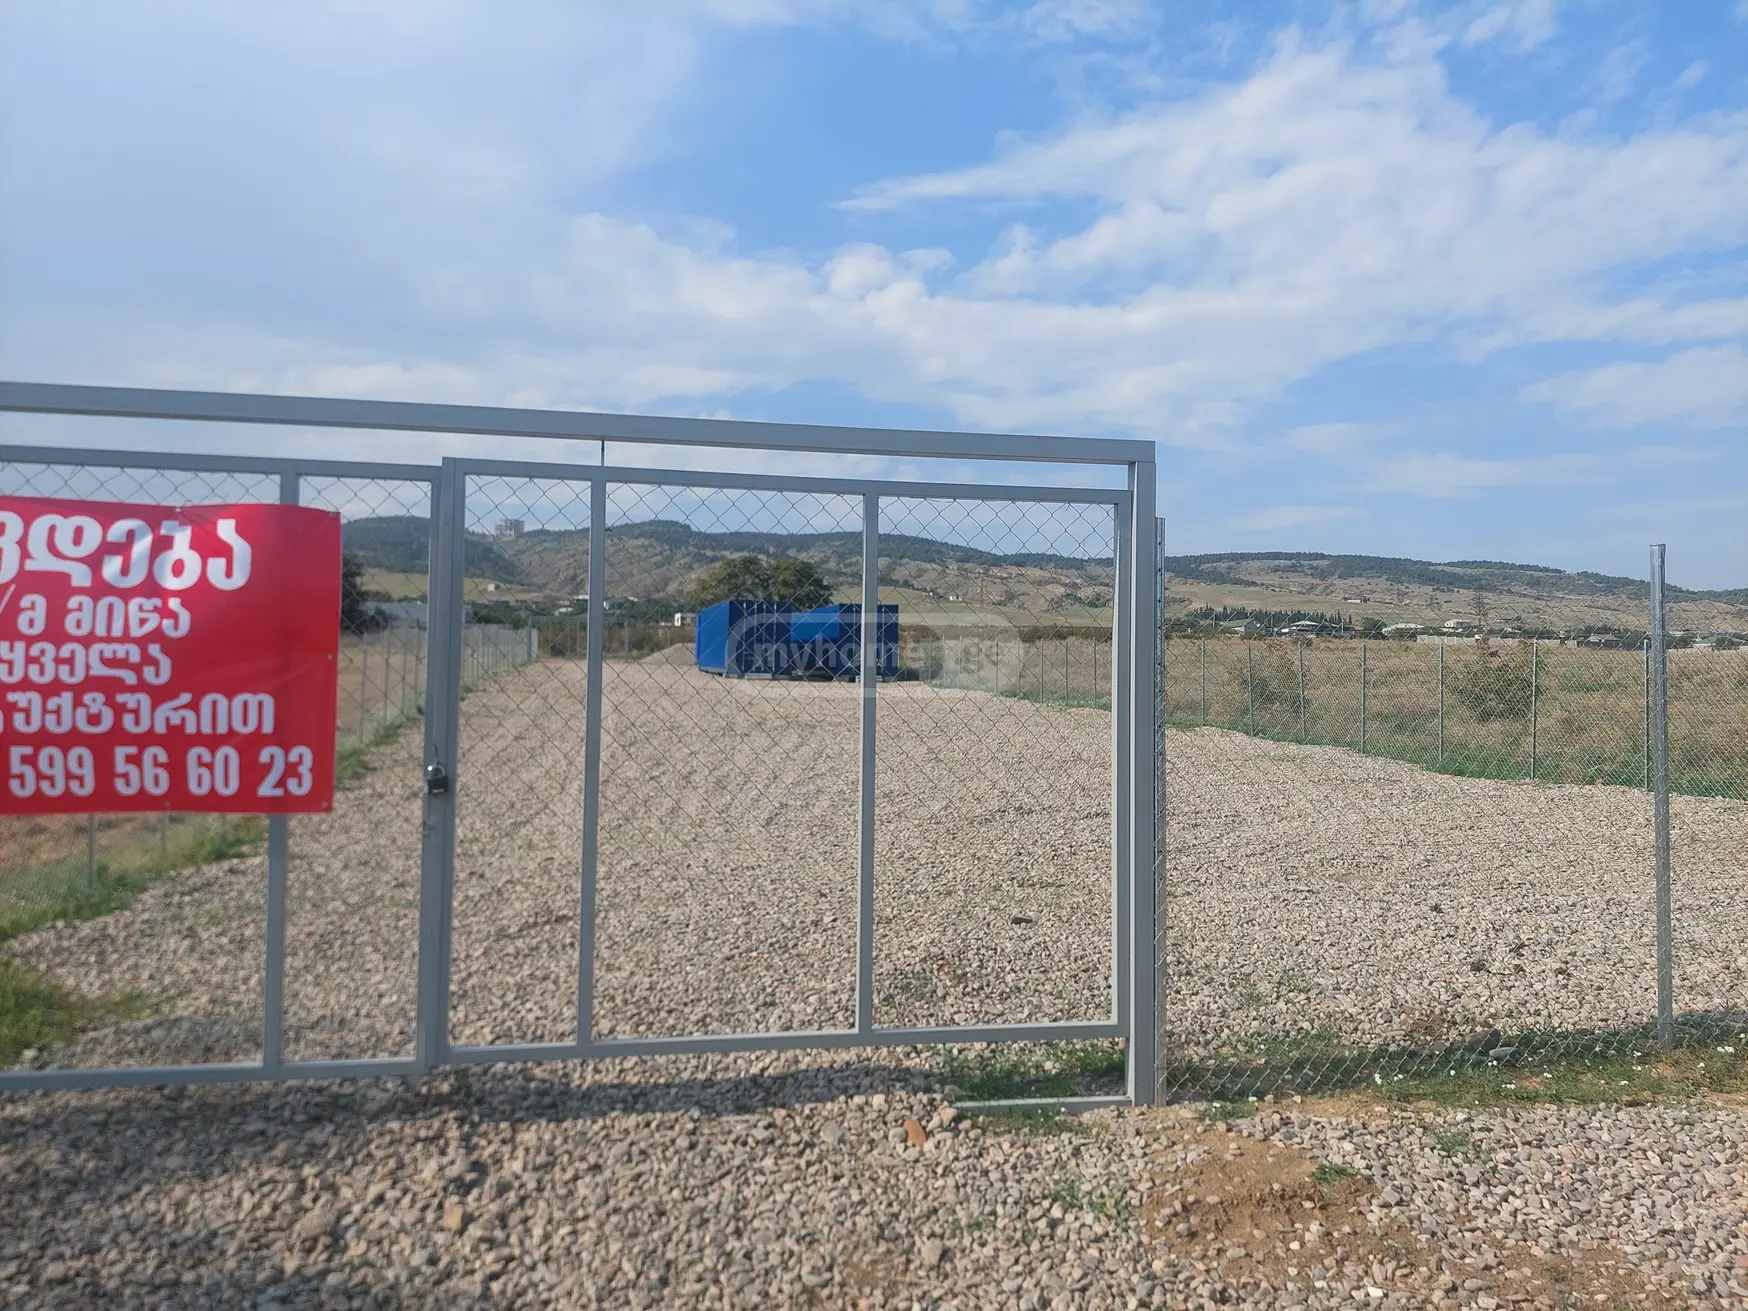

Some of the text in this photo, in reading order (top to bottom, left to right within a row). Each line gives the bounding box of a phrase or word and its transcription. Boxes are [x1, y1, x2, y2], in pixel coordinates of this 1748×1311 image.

[64, 594, 191, 638] მიწა
[0, 640, 172, 685] ყველა
[0, 691, 275, 735] უქტურით
[8, 745, 313, 798] 599 56 60 23
